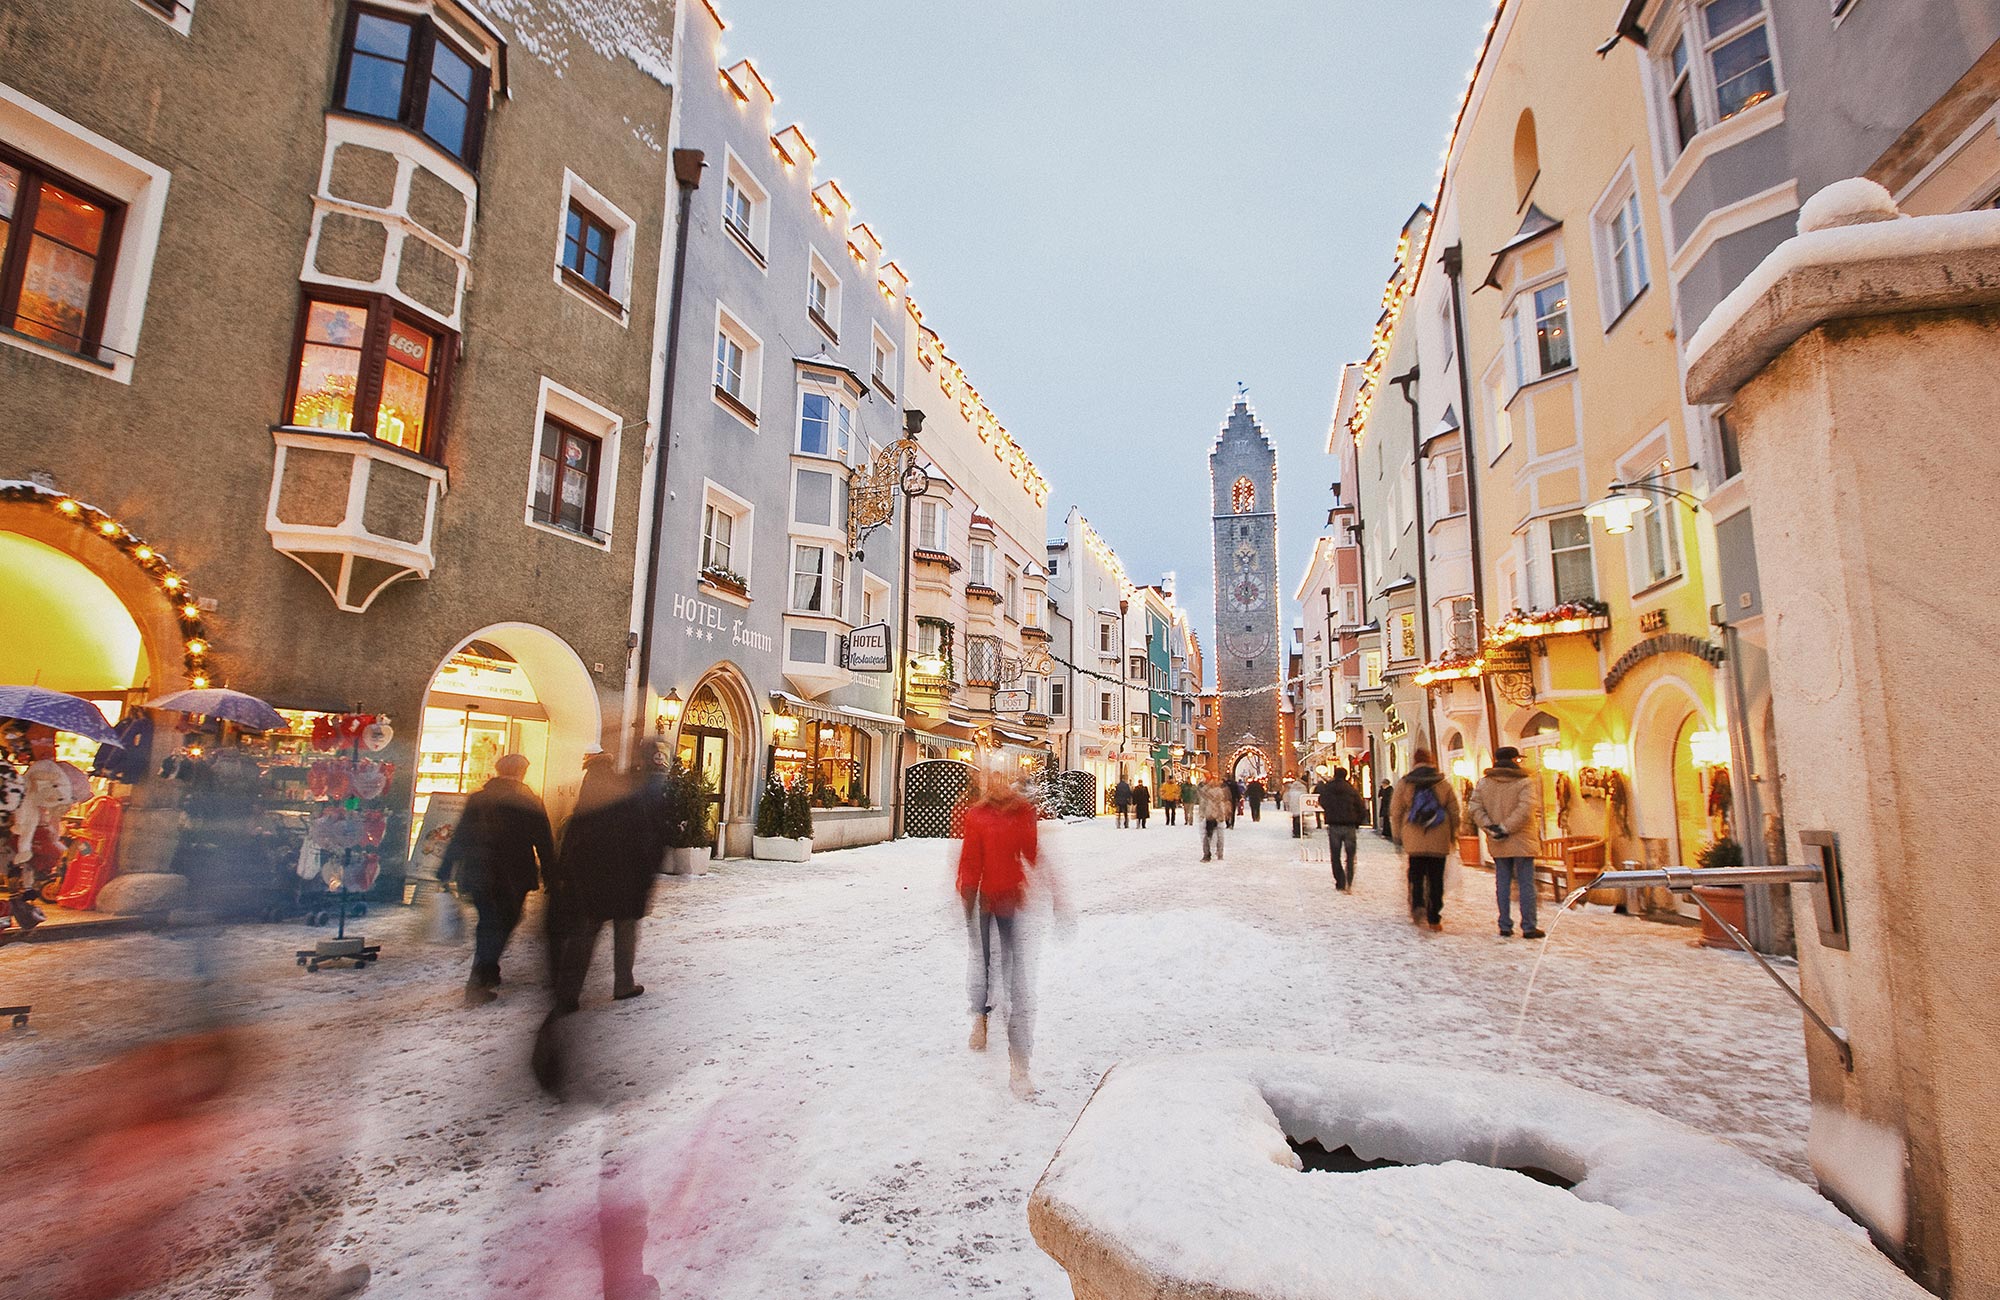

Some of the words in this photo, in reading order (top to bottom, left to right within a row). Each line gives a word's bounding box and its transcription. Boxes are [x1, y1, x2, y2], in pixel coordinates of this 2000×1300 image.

[389, 333, 424, 359] LEGO
[673, 593, 727, 632] HOTEL
[732, 619, 772, 653] Lamm
[853, 635, 884, 648] HOTEL
[850, 653, 887, 666] Restaurant
[1002, 698, 1023, 708] POST
